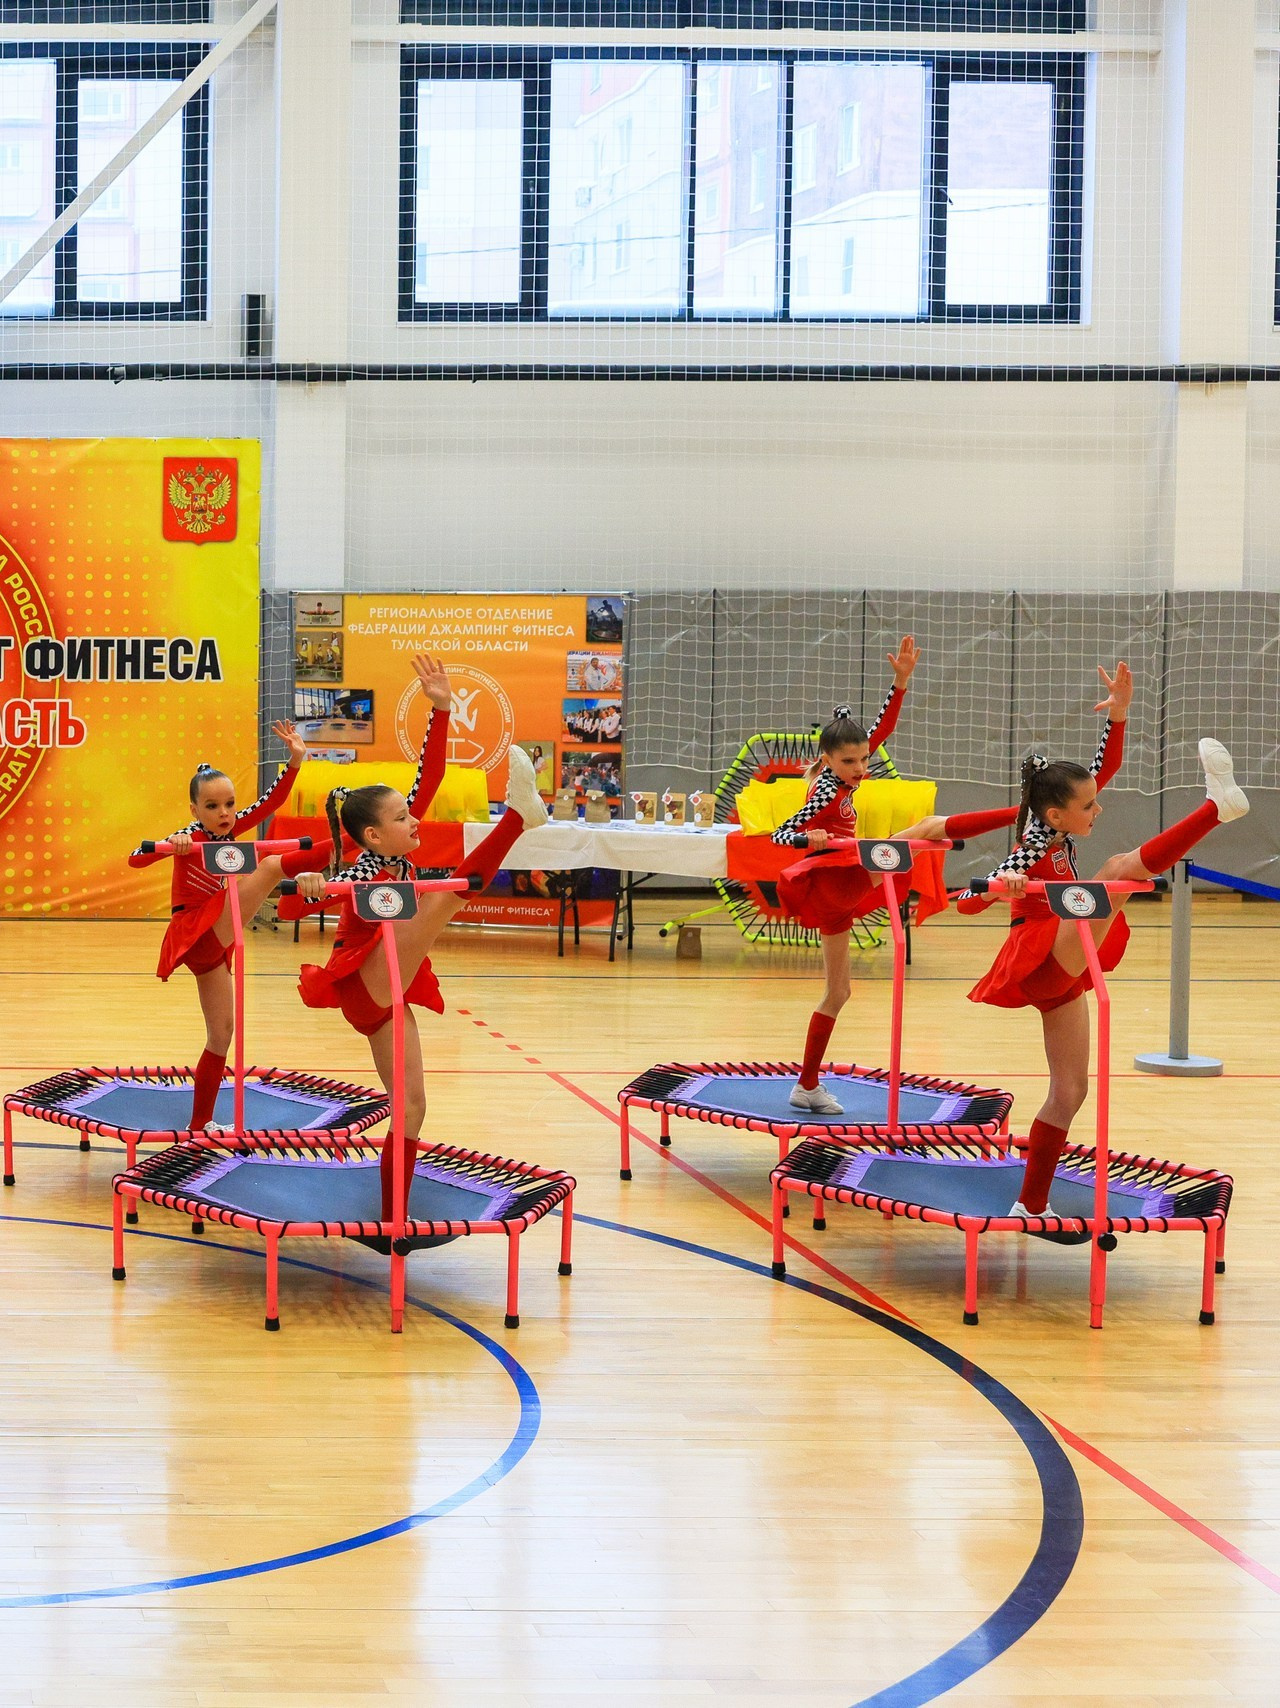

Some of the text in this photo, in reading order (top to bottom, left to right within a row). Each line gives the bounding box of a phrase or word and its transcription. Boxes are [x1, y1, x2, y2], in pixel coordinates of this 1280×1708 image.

[3, 572, 46, 642] РОСС
[369, 607, 553, 620] РЕГИОНАЛЬНОЕ ОТДЕЛЕНИЕ
[348, 623, 575, 637] ФЕДЕРАЦИИ ДЖАМПИНГ ФИТНЕСА
[391, 637, 529, 652] ТУЛЬСКОЙ ОБЛАСТИ
[23, 635, 224, 682] ФИТНЕСА
[497, 692, 511, 723] РОССИИ
[398, 729, 511, 771] RUSSIAN FEDERATION
[461, 905, 555, 916] АМПИНГ ФИТНЕСА"
